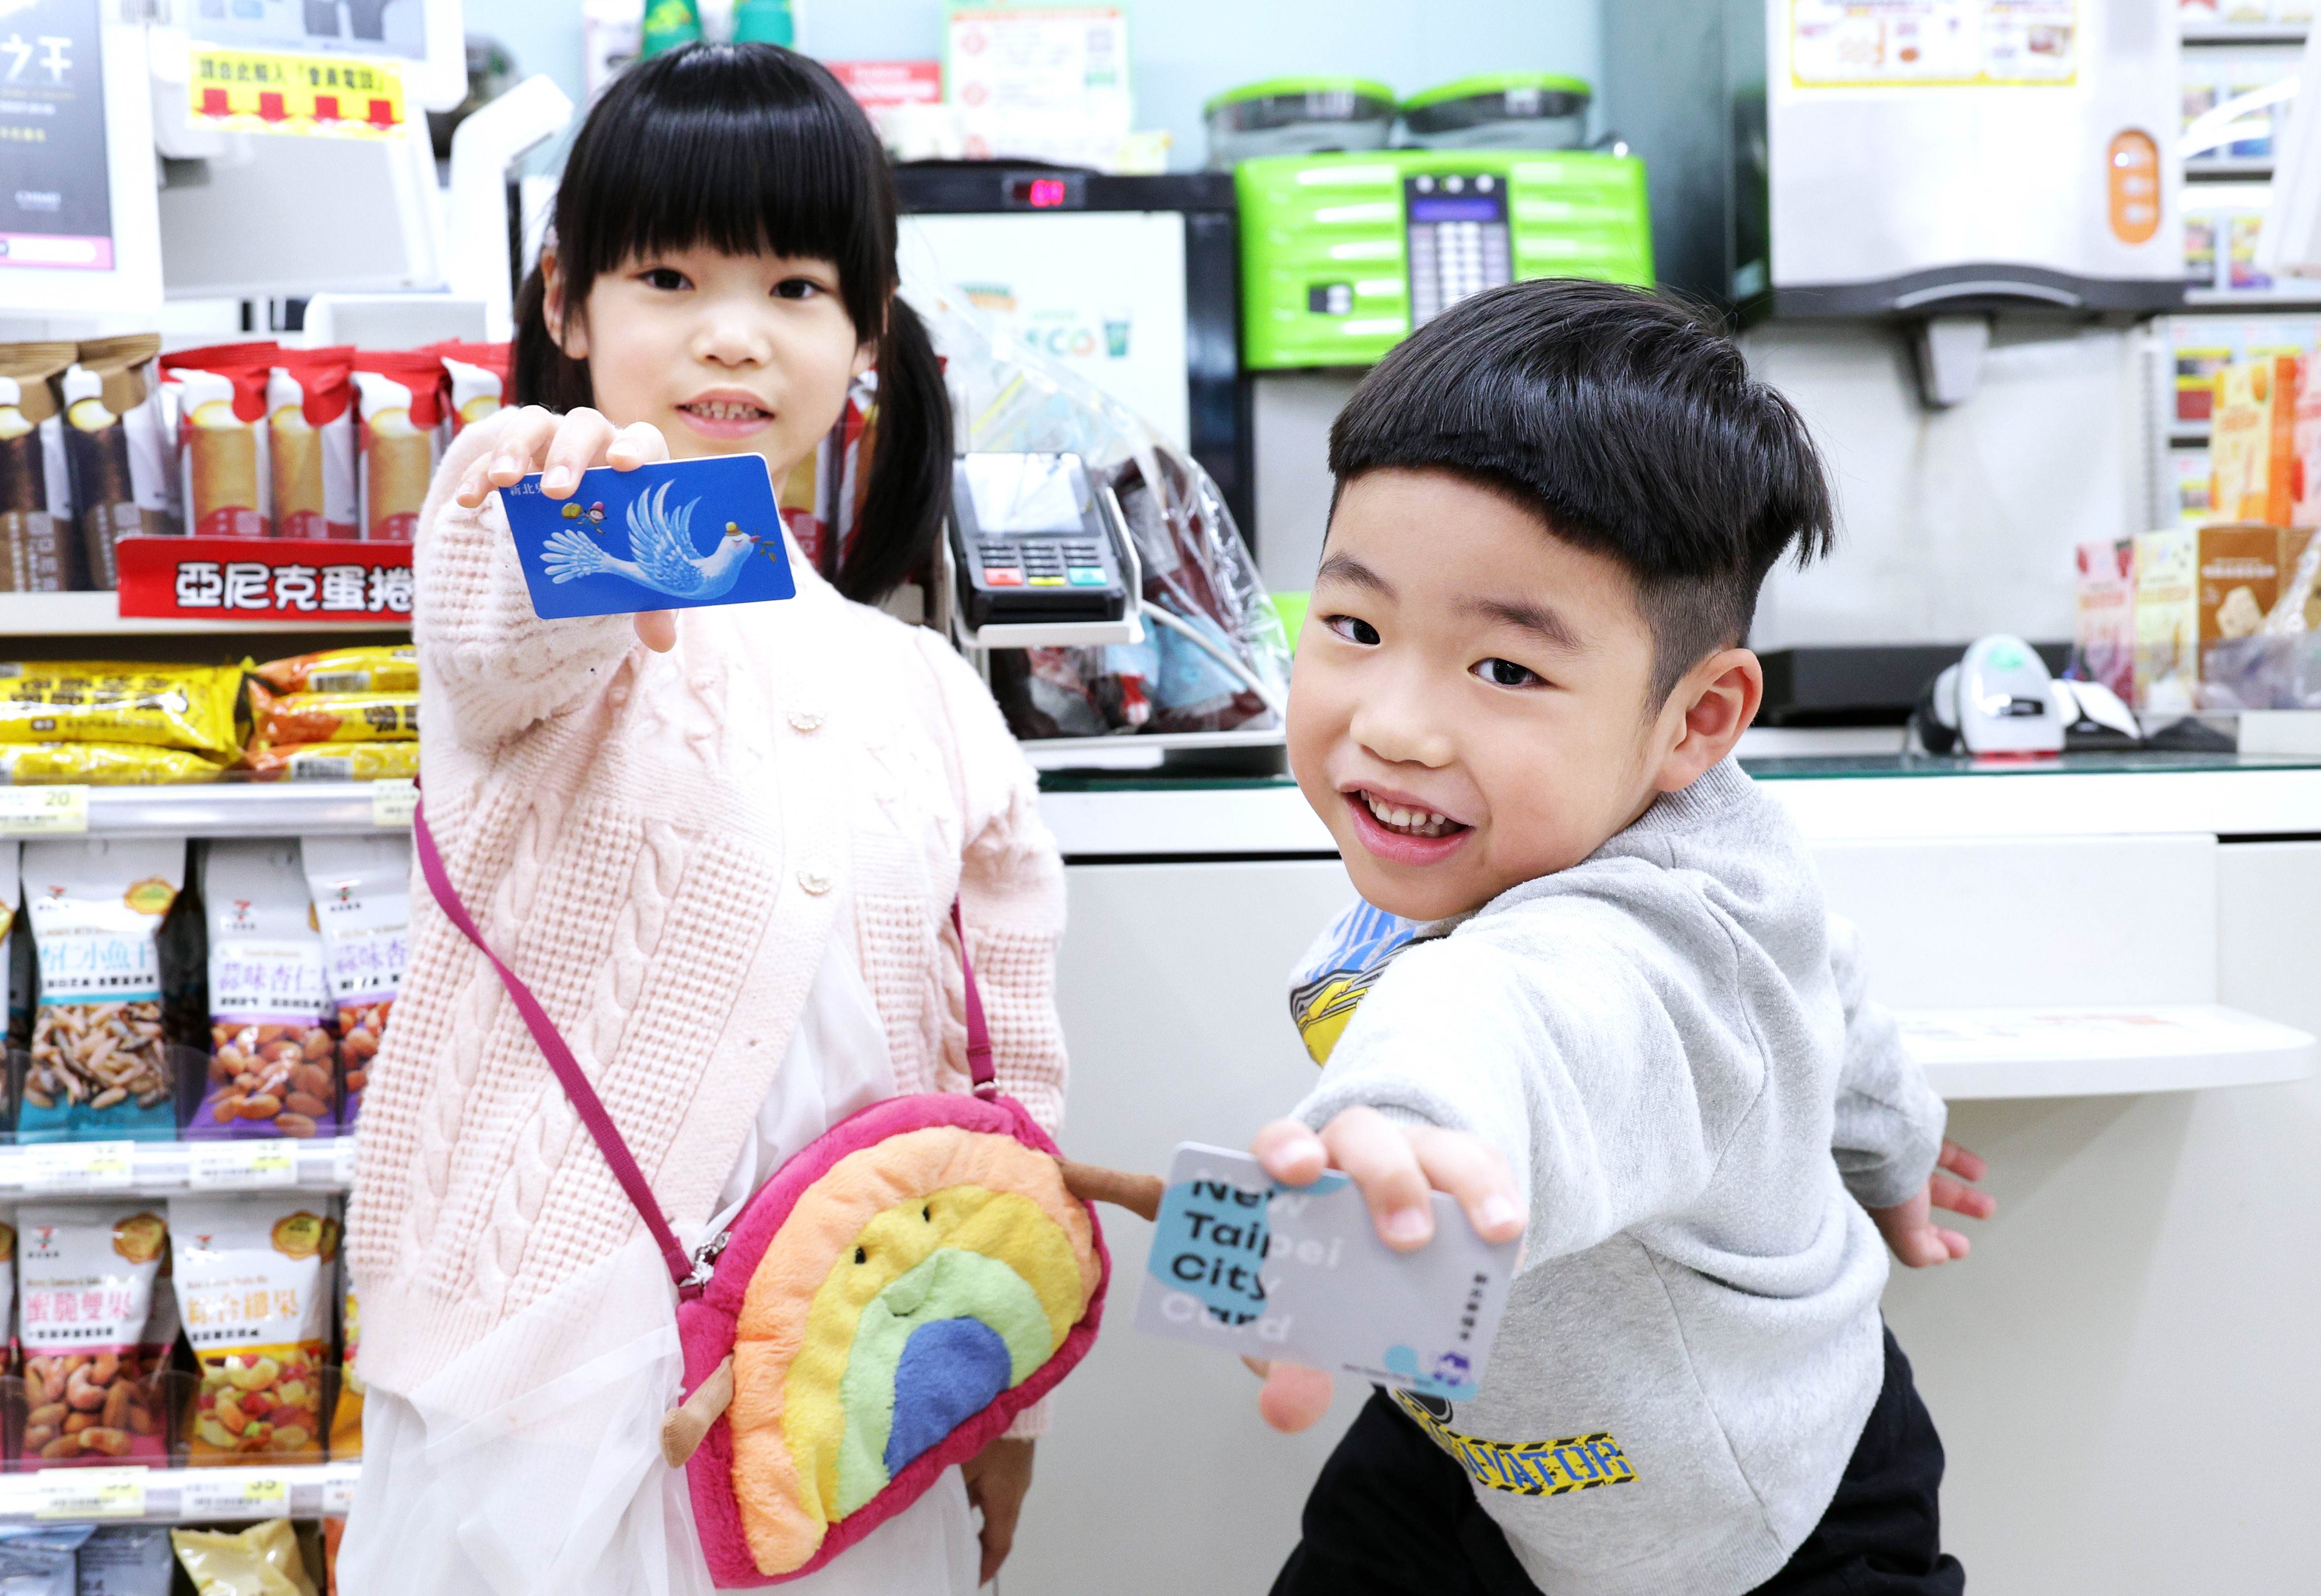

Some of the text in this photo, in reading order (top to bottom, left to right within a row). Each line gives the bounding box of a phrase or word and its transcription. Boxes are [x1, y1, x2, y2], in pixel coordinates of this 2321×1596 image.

[176, 561, 412, 612] 亞尼克蛋捲
[1184, 1210, 1343, 1270] Taipei
[1171, 1252, 1282, 1301] City
[1160, 1293, 1294, 1344] Card
